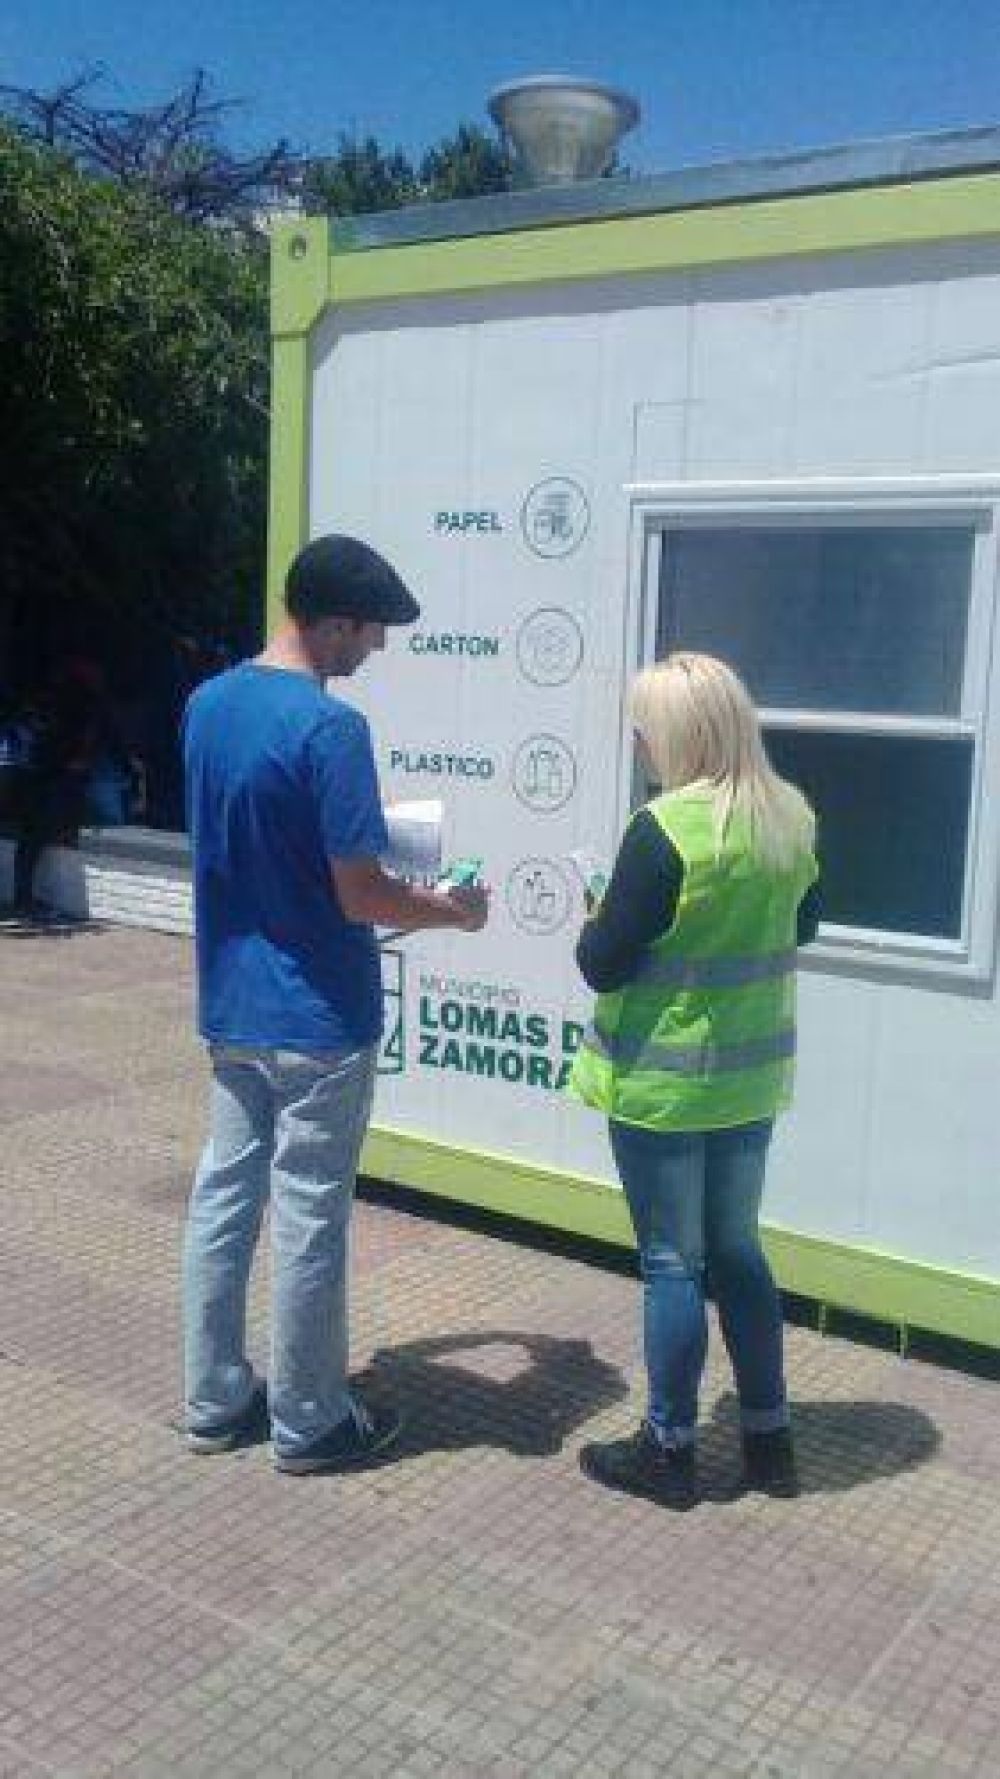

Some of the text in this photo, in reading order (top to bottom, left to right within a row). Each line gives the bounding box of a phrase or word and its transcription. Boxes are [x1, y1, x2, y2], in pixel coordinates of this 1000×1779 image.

[436, 511, 502, 531] PAPEL
[409, 633, 499, 655] CARTON
[391, 751, 495, 779] PLASTICO
[419, 996, 584, 1053] LOMAS D
